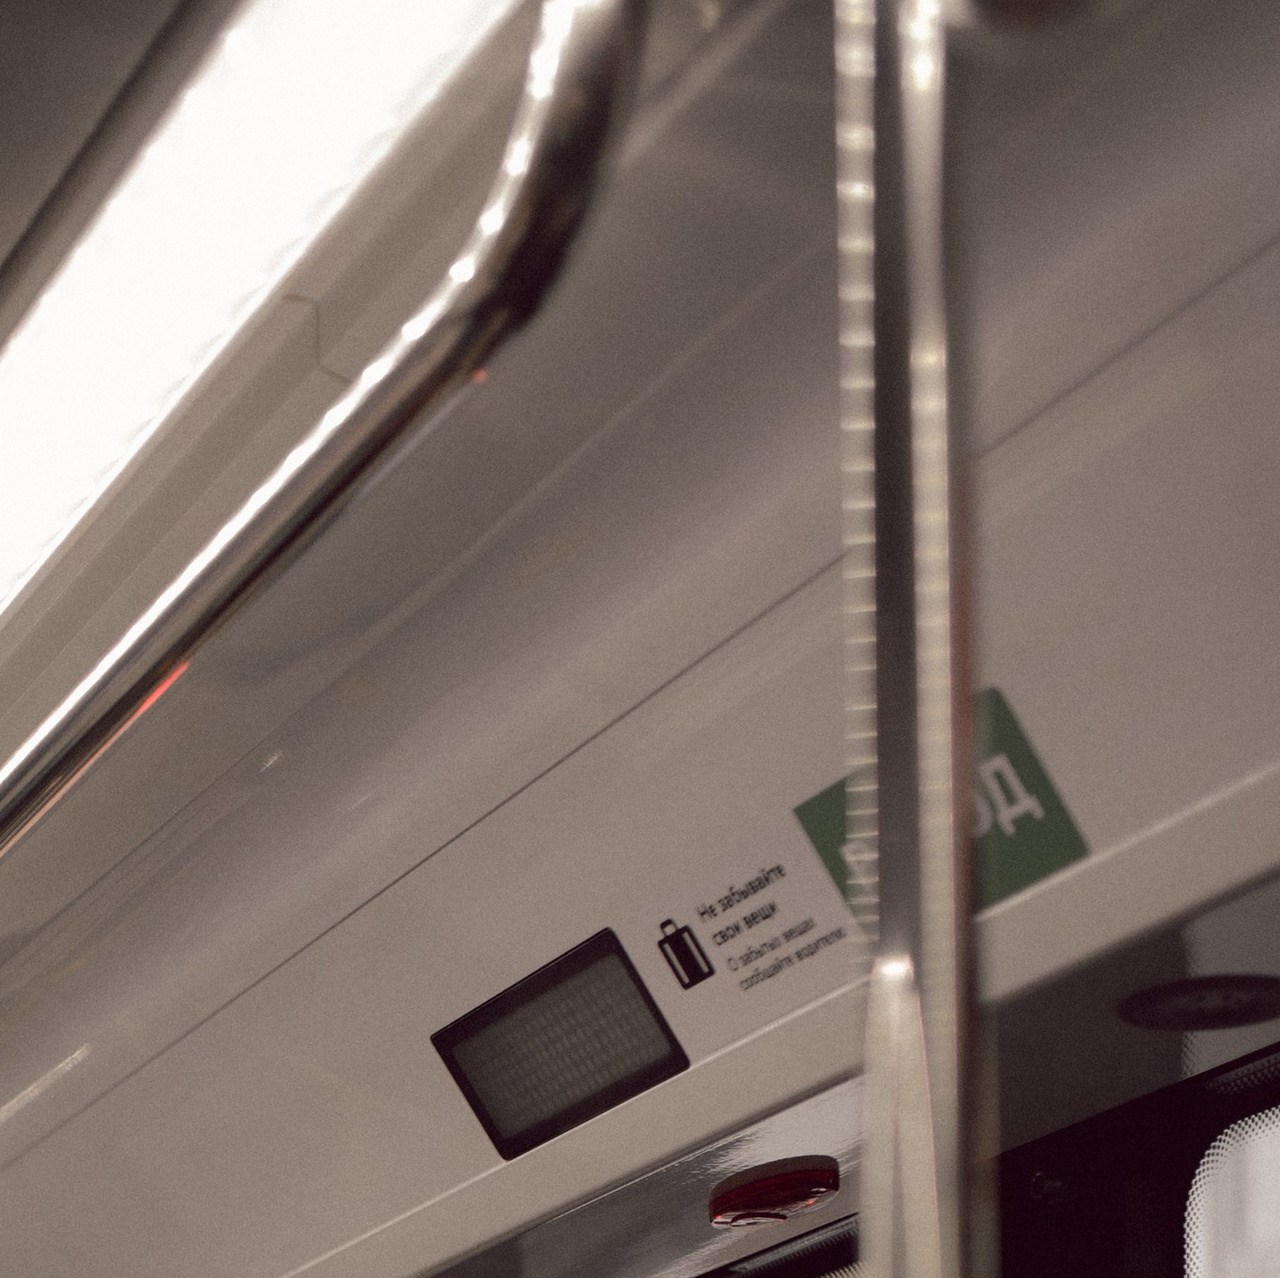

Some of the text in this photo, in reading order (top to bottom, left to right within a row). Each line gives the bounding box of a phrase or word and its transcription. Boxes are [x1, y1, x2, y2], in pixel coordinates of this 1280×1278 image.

[698, 865, 786, 922] Не забывайте
[712, 901, 777, 946] свои вещи
[739, 955, 794, 991] сообщайте
